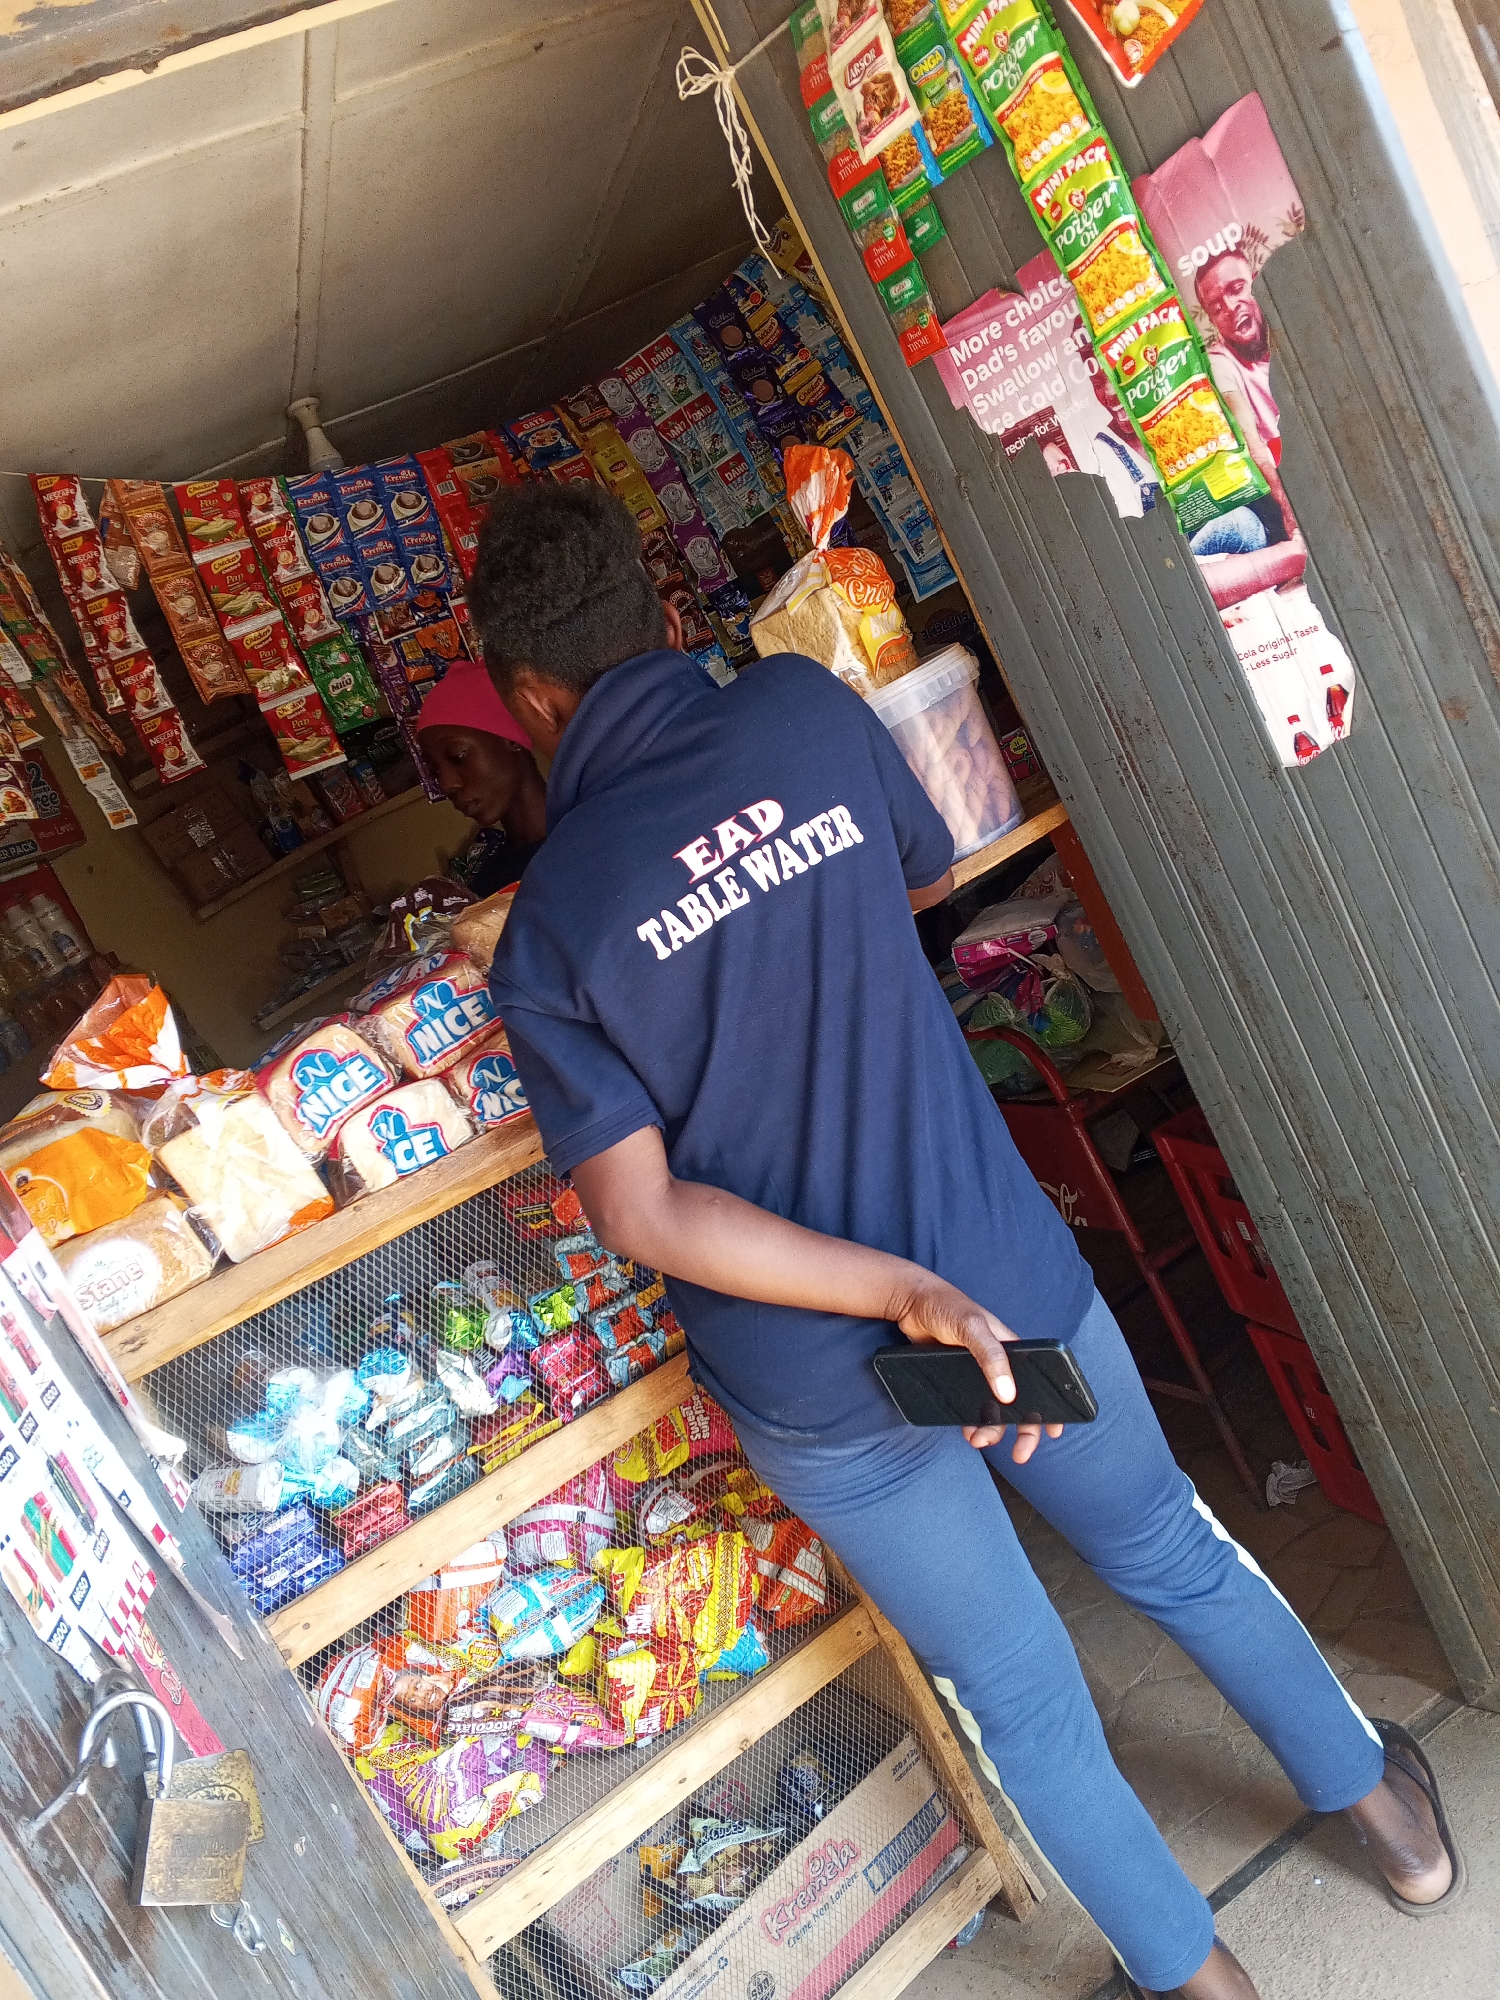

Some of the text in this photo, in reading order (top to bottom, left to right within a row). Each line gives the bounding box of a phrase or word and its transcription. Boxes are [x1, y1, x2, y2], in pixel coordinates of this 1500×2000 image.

[910, 49, 943, 81] ONGA
[1036, 145, 1107, 209] MINI PACK
[1080, 225, 1100, 248] Oil
[873, 240, 887, 256] Dried
[873, 249, 898, 268] THYME
[1177, 222, 1244, 278] soup
[907, 327, 922, 341] Dried
[907, 335, 930, 353] THYME
[949, 321, 1003, 367] More
[1107, 306, 1182, 361] MINI PACK
[650, 346, 674, 366] DANO
[962, 343, 1018, 391] Dad's
[972, 347, 1059, 415] Swallow
[1017, 374, 1068, 417] Cold
[1153, 381, 1174, 404] Oil
[522, 416, 546, 430] OATS
[1034, 421, 1050, 438] for
[384, 469, 417, 484] Kremela
[724, 462, 749, 481] DANO
[340, 479, 374, 496] Kremela
[199, 497, 219, 509] Pap
[296, 492, 330, 508] Kremela
[361, 541, 395, 559] Kremela
[403, 532, 438, 547] Kremela
[212, 552, 241, 573] Checkers
[320, 555, 354, 573] Kremela
[225, 573, 244, 585] Pap
[244, 626, 272, 648] Checkers
[1258, 635, 1293, 654] Original
[1293, 624, 1319, 640] Taste
[258, 647, 278, 659] Pap
[1250, 647, 1298, 672] Less Sugar
[331, 677, 353, 692] MILO
[290, 717, 310, 728] Pap
[672, 798, 786, 884] EAD
[636, 804, 865, 961] TABLE WATER
[412, 996, 490, 1059] NICE
[300, 1057, 379, 1128] NICE
[482, 1081, 530, 1121] NIC
[74, 1258, 144, 1311] Stane
[763, 1841, 858, 1941] Kremela
[813, 1903, 830, 1920] Non
